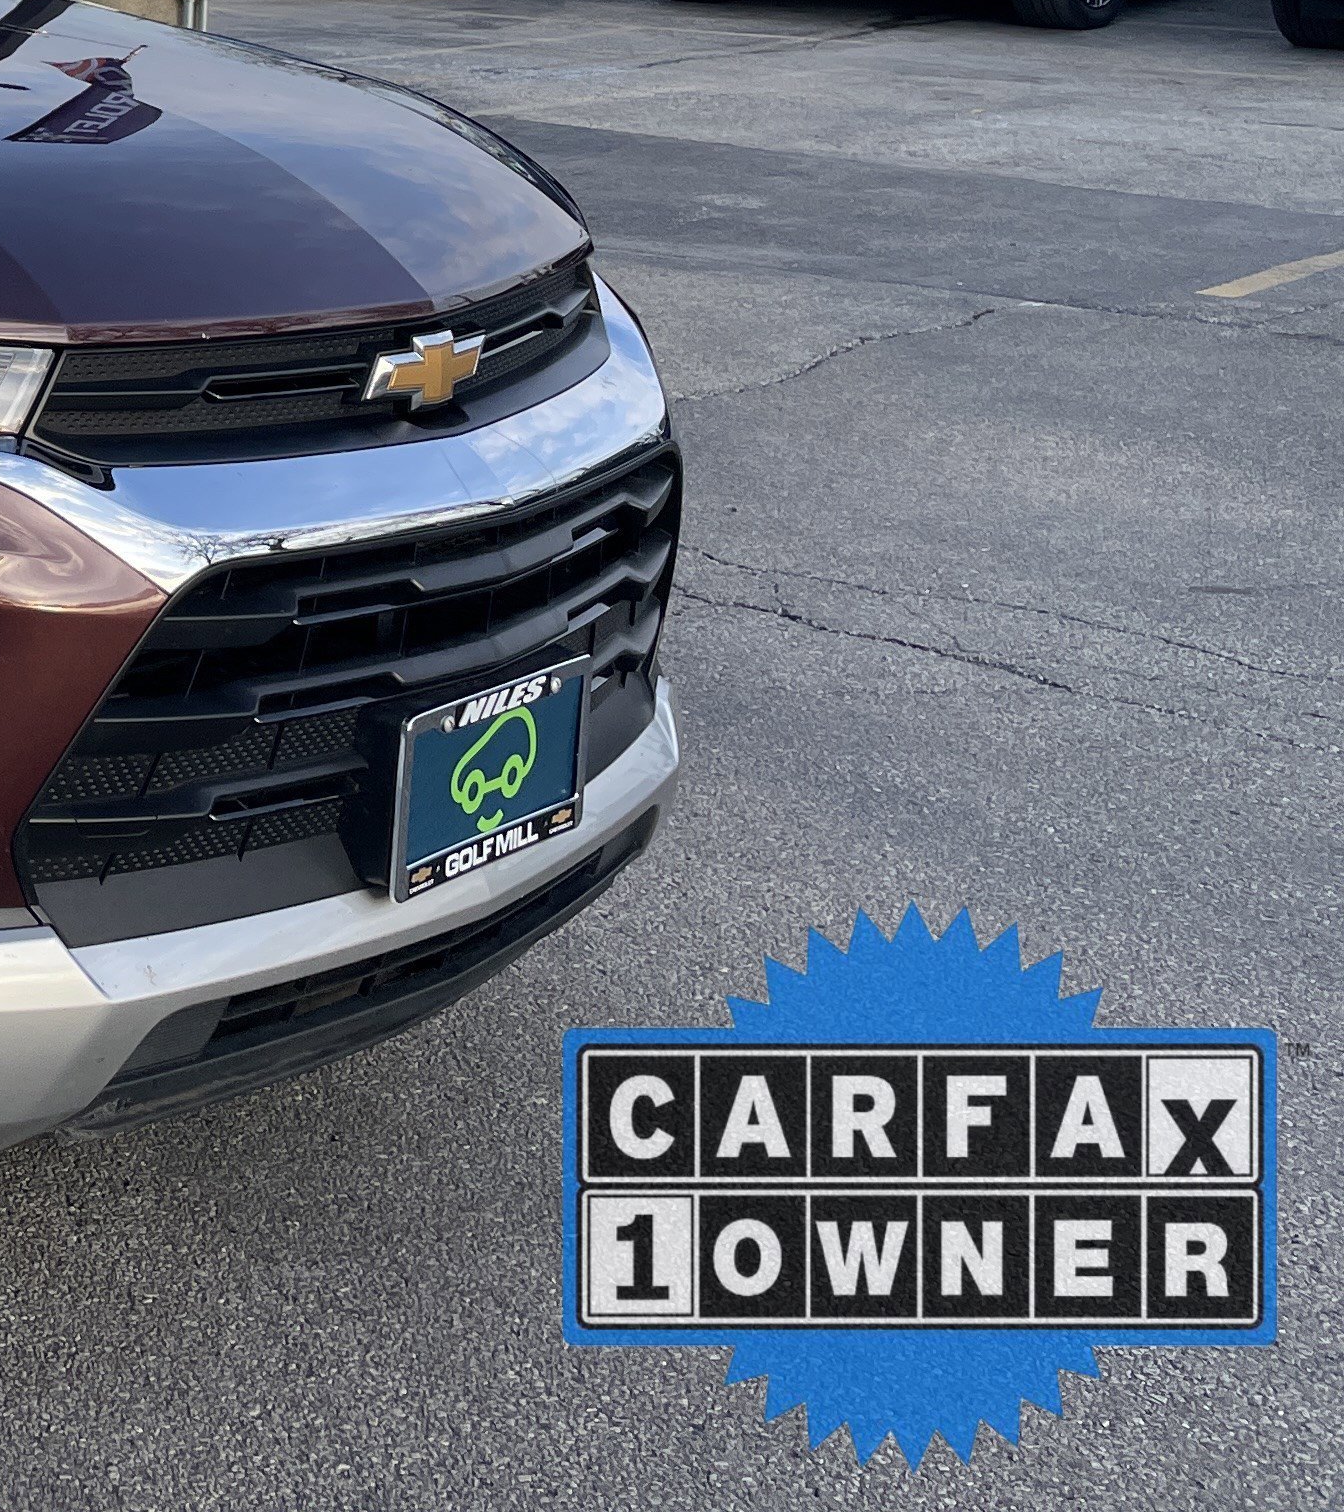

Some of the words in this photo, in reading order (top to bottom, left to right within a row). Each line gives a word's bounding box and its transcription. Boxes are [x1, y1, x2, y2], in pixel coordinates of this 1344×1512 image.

[458, 675, 548, 727] NILES
[444, 836, 495, 878] GOLF
[495, 821, 539, 857] MILL
